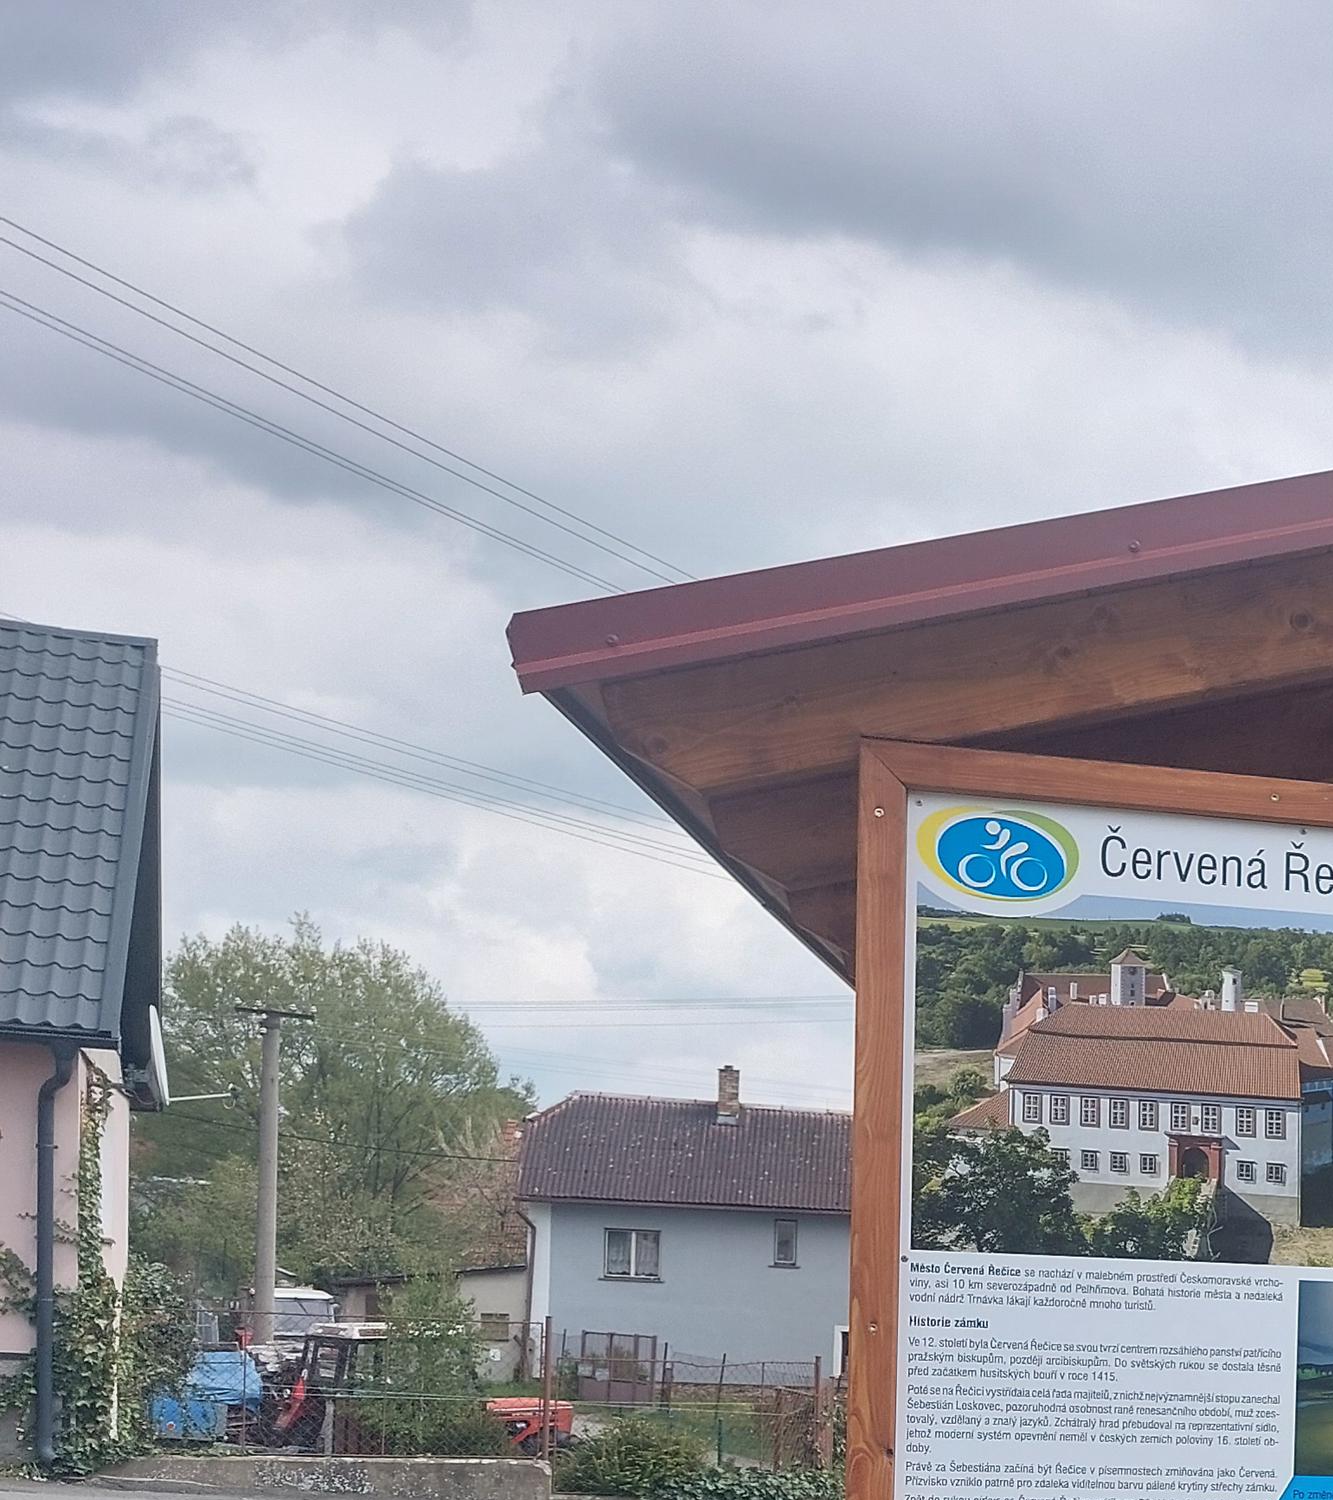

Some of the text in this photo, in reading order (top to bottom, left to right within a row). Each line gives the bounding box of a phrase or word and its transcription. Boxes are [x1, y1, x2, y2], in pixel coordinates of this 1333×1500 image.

[1100, 825, 1268, 890] Červená
[910, 1262, 940, 1273] Město
[944, 1261, 984, 1275] Červená
[988, 1263, 1021, 1277] Řečice
[1024, 1269, 1035, 1278] se
[1038, 1267, 1074, 1279] nachází
[1077, 1271, 1082, 1279] v
[1254, 1277, 1282, 1287] vrcho-
[909, 1278, 931, 1290] viny,
[934, 1279, 948, 1289] asi
[953, 1278, 965, 1289] 10
[968, 1279, 983, 1290] km
[1059, 1282, 1071, 1293] od
[1132, 1285, 1164, 1297] Bohatá
[1204, 1288, 1231, 1299] města
[1235, 1291, 1240, 1300] a
[909, 1291, 935, 1303] vodní
[967, 1293, 1003, 1305] Trnávka
[1089, 1298, 1122, 1310] mnoho
[909, 1315, 988, 1328] Historie zámku
[908, 1336, 920, 1347] Ve
[922, 1336, 936, 1347] 12.
[968, 1338, 988, 1351] byla
[989, 1337, 1028, 1350] Červená
[1030, 1338, 1062, 1351] Řečice
[1063, 1343, 1074, 1352] se
[1075, 1344, 1098, 1352] svou
[1120, 1344, 1157, 1355] centrem
[908, 1350, 954, 1364] pražským
[957, 1351, 1006, 1365] biskupům,
[1009, 1354, 1043, 1367] později
[1114, 1357, 1127, 1368] Do
[1130, 1358, 1176, 1371] světských
[1179, 1361, 1205, 1370] rukou
[1208, 1362, 1218, 1371] se
[907, 1365, 929, 1378] před
[1059, 1372, 1065, 1380] v
[1067, 1372, 1088, 1381] roce
[1092, 1371, 1117, 1382] 1415.
[907, 1384, 928, 1395] Poté
[929, 1386, 940, 1395] se
[942, 1387, 953, 1395] na
[955, 1383, 984, 1396] Řečici
[1031, 1388, 1050, 1398] celá
[1215, 1394, 1240, 1405] stopu
